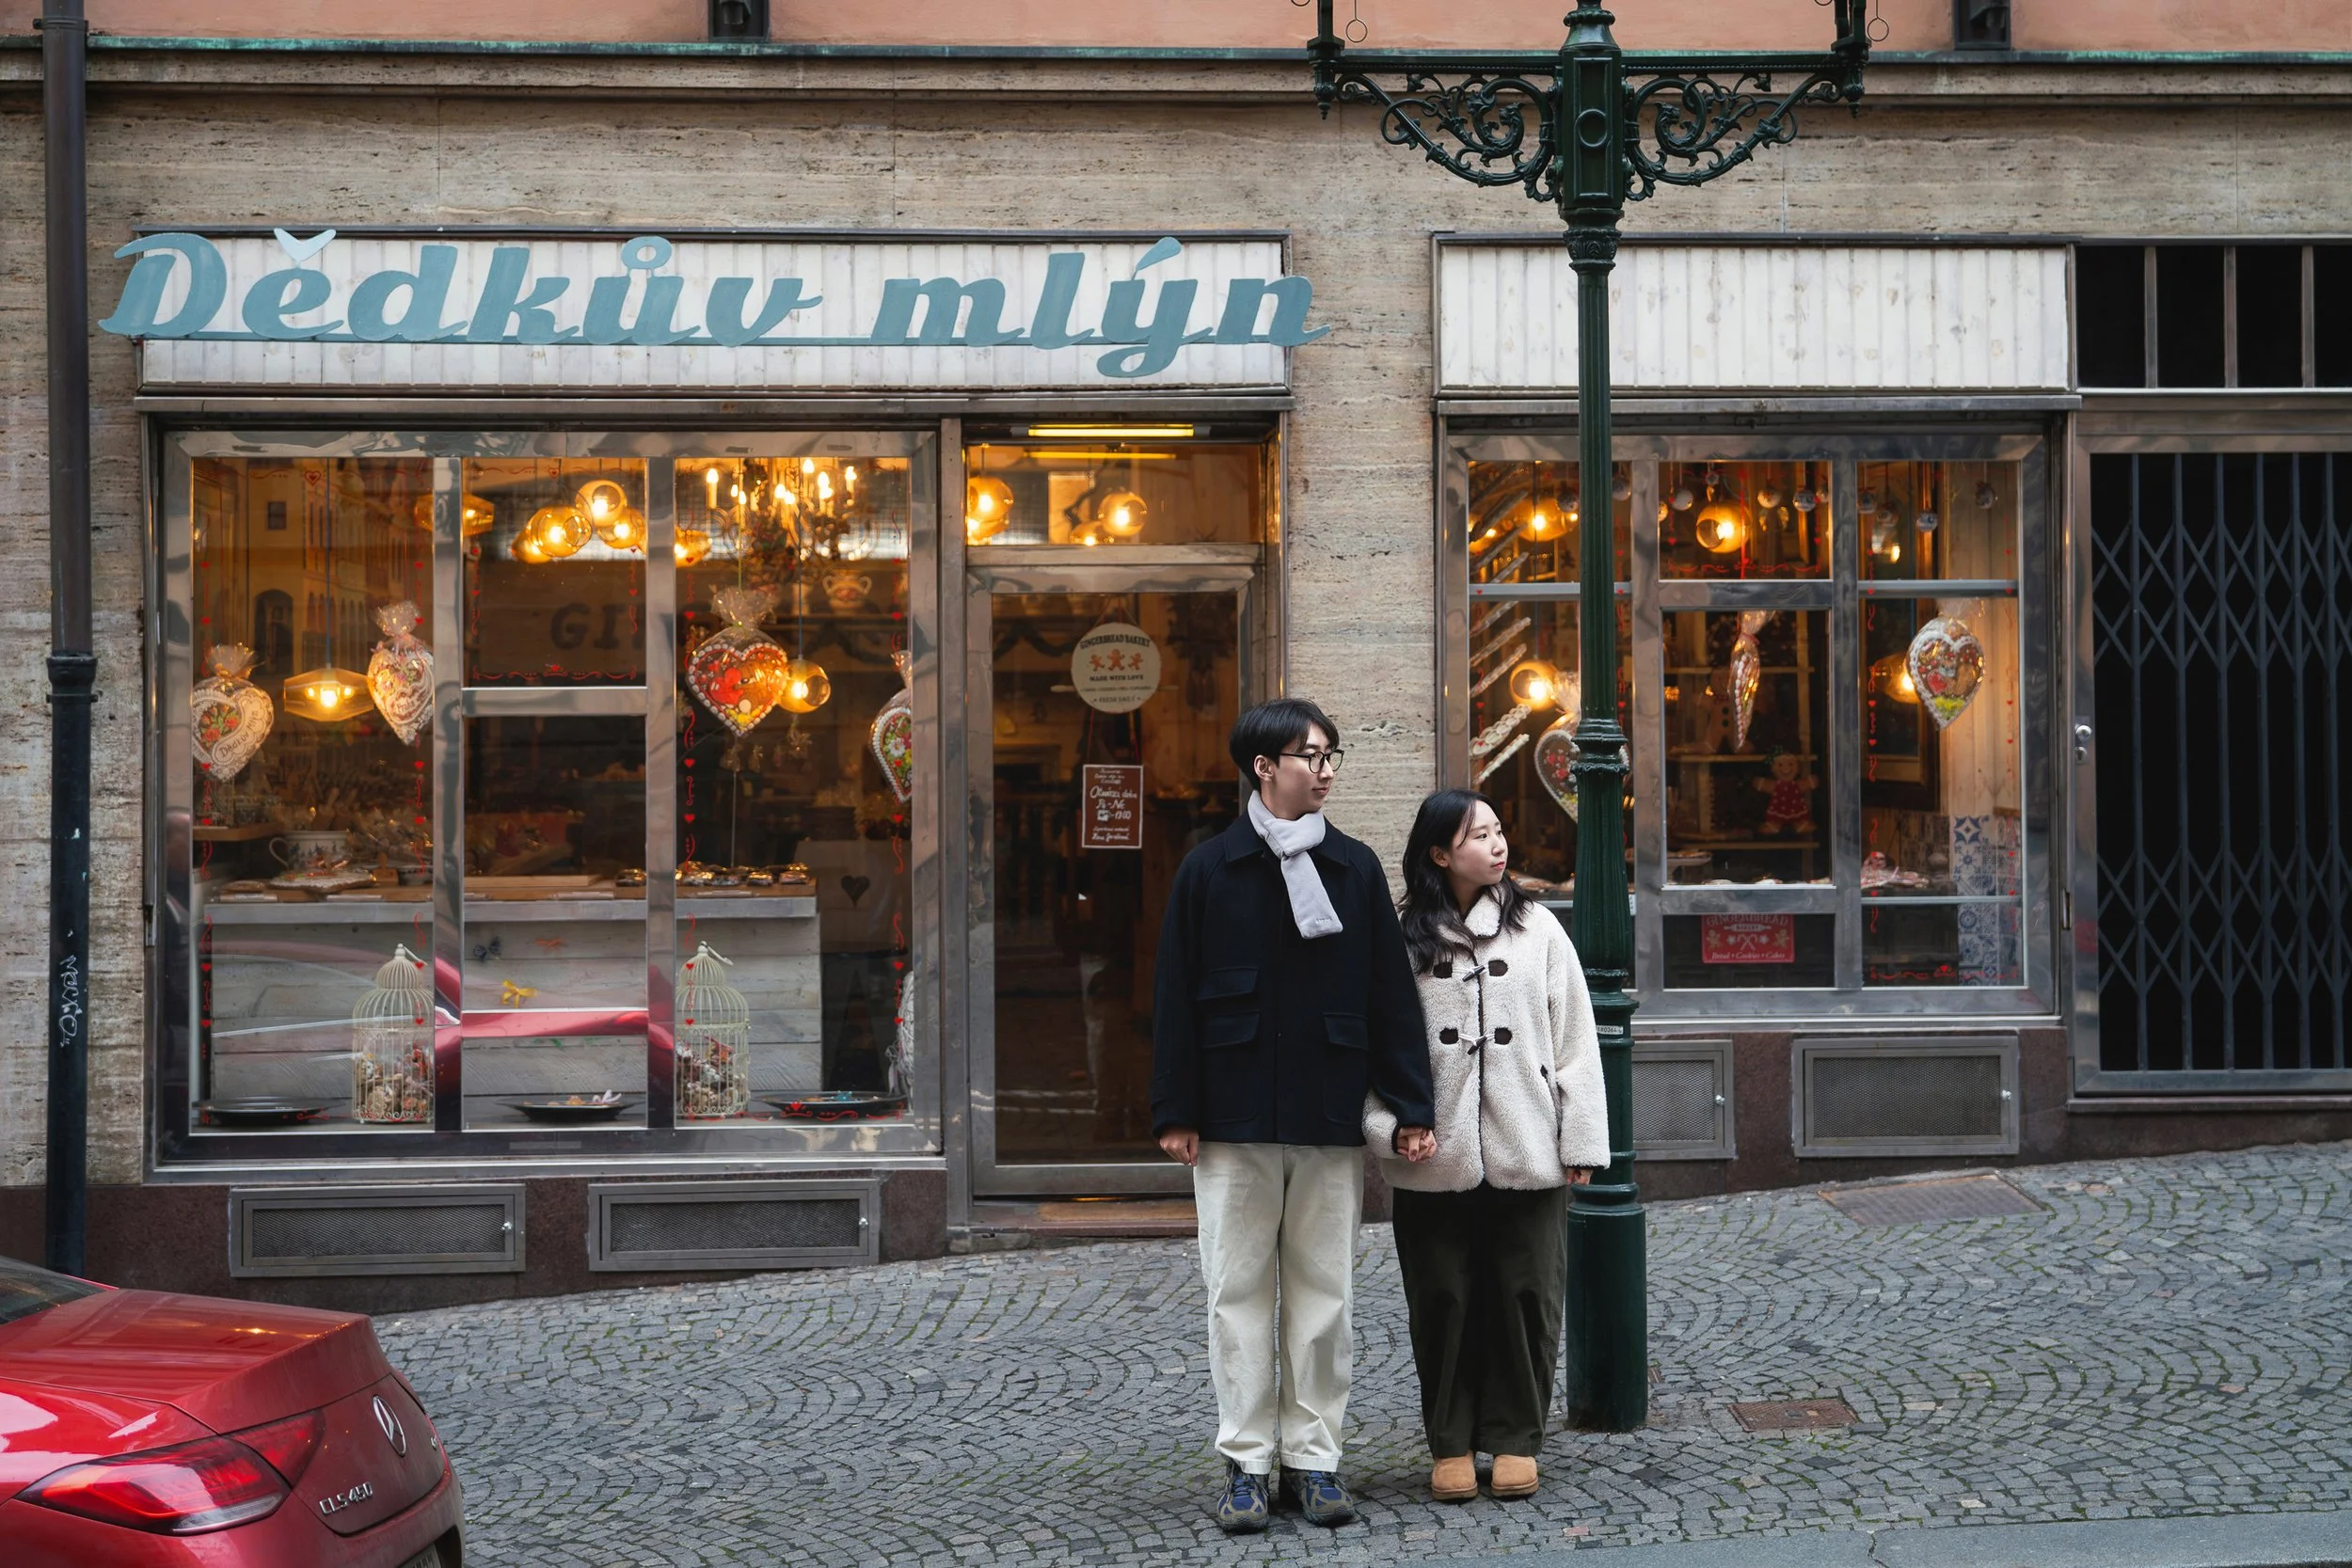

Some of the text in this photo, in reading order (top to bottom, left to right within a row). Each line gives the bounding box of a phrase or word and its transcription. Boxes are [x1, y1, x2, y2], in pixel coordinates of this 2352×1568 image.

[98, 228, 1331, 377] Dědkův mlýn
[1079, 634, 1151, 650] GINGERBREAD BAKERY
[1707, 913, 1788, 927] GINGERBREAD
[319, 1481, 373, 1514] CLS 450
